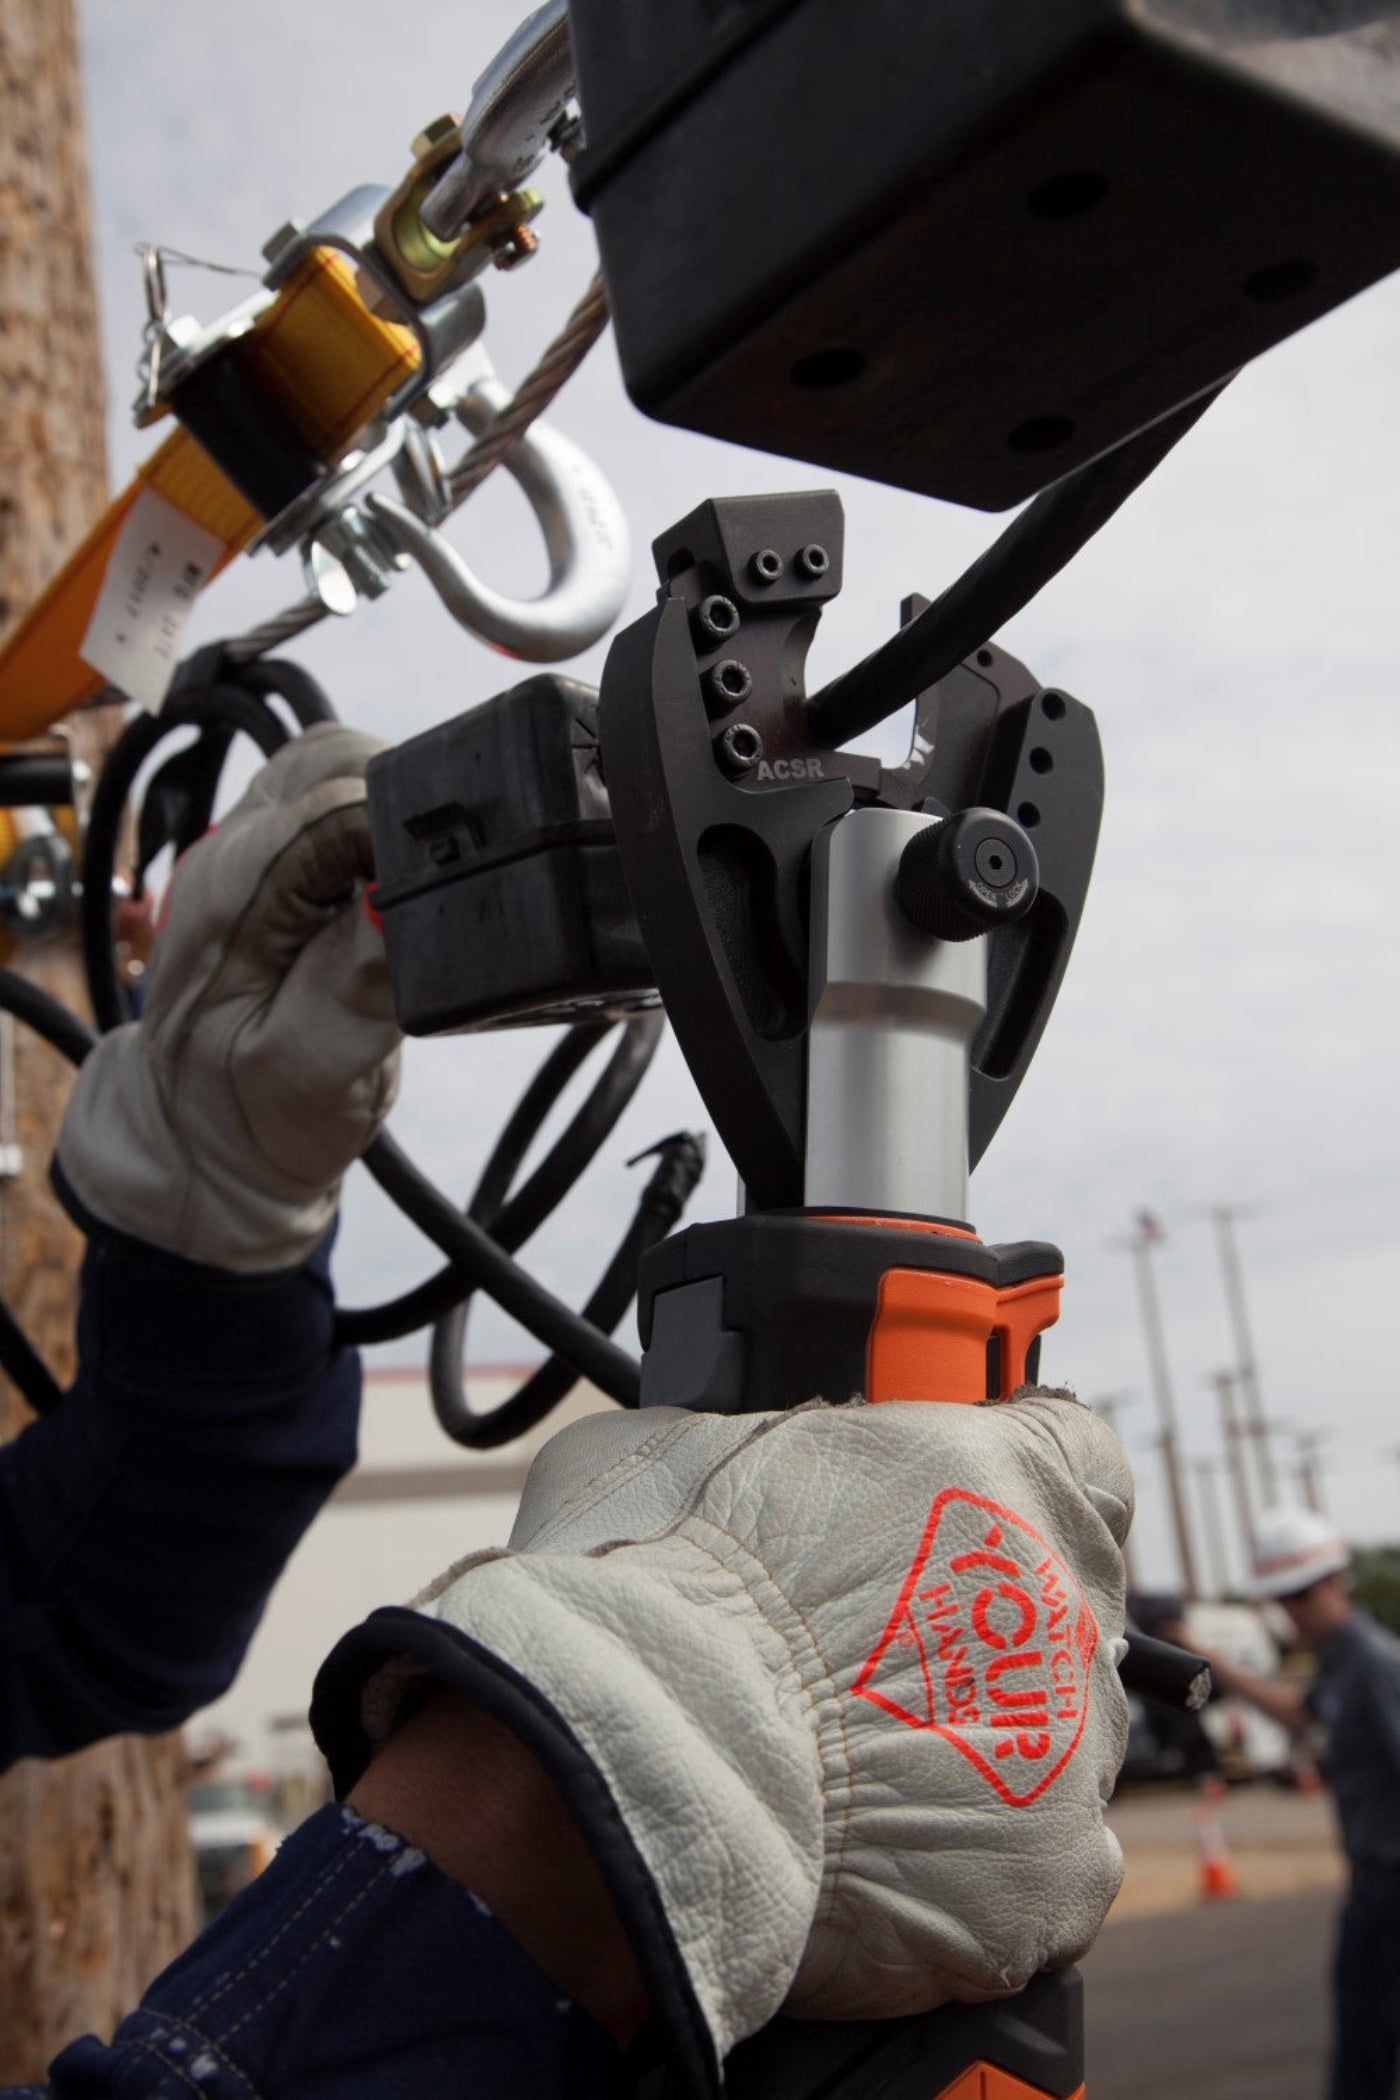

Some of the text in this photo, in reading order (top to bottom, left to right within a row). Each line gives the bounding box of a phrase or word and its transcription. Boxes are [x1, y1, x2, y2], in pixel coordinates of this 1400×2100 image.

[758, 758, 825, 780] ACSR
[918, 1583, 981, 1726] HANDS
[950, 1524, 1051, 1761] YOUR
[1034, 1557, 1078, 1719] WATCH
